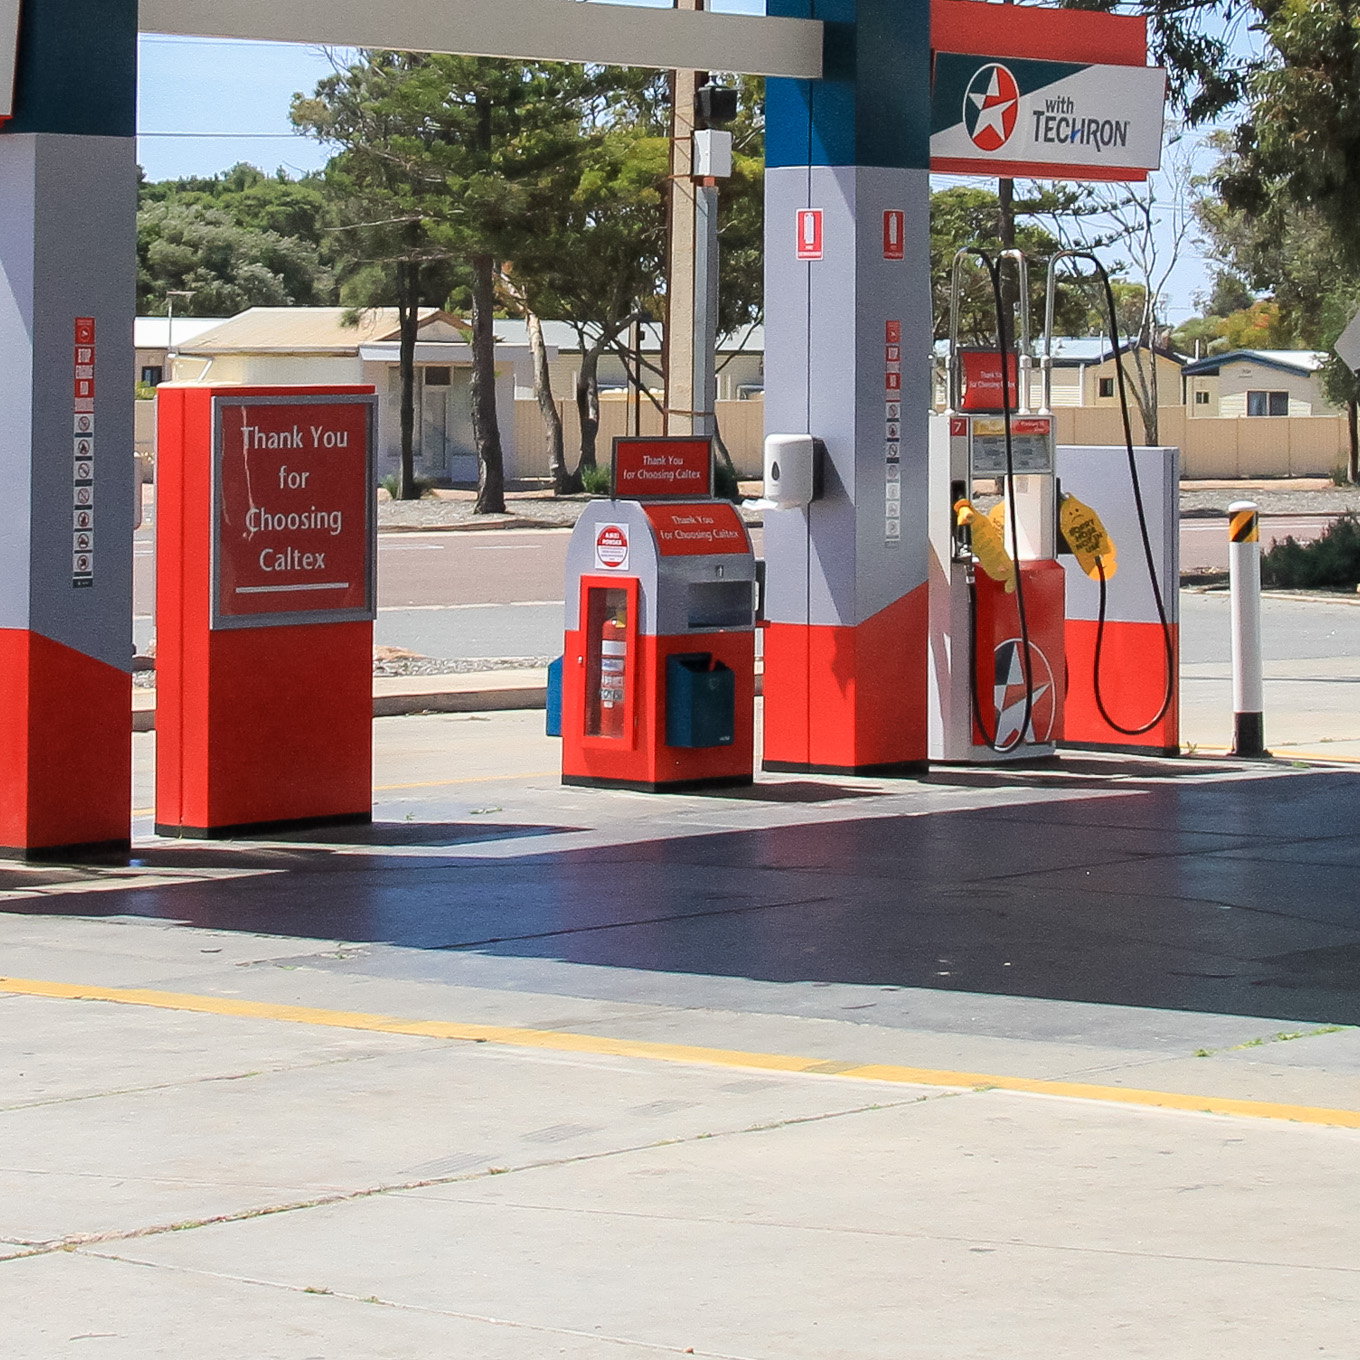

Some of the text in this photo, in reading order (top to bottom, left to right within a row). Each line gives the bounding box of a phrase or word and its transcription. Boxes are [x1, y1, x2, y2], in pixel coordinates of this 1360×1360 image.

[1044, 95, 1075, 116] with
[1032, 110, 1128, 153] TECHRON
[240, 424, 349, 450] Thank You
[953, 421, 962, 433] 7
[642, 454, 684, 466] Thank You
[278, 464, 310, 490] for
[623, 468, 702, 482] for Choosing Caltex
[245, 505, 343, 536] Choosing
[1069, 518, 1095, 537] SORRY
[1074, 526, 1098, 543] HOSE
[258, 546, 326, 572] Caltex
